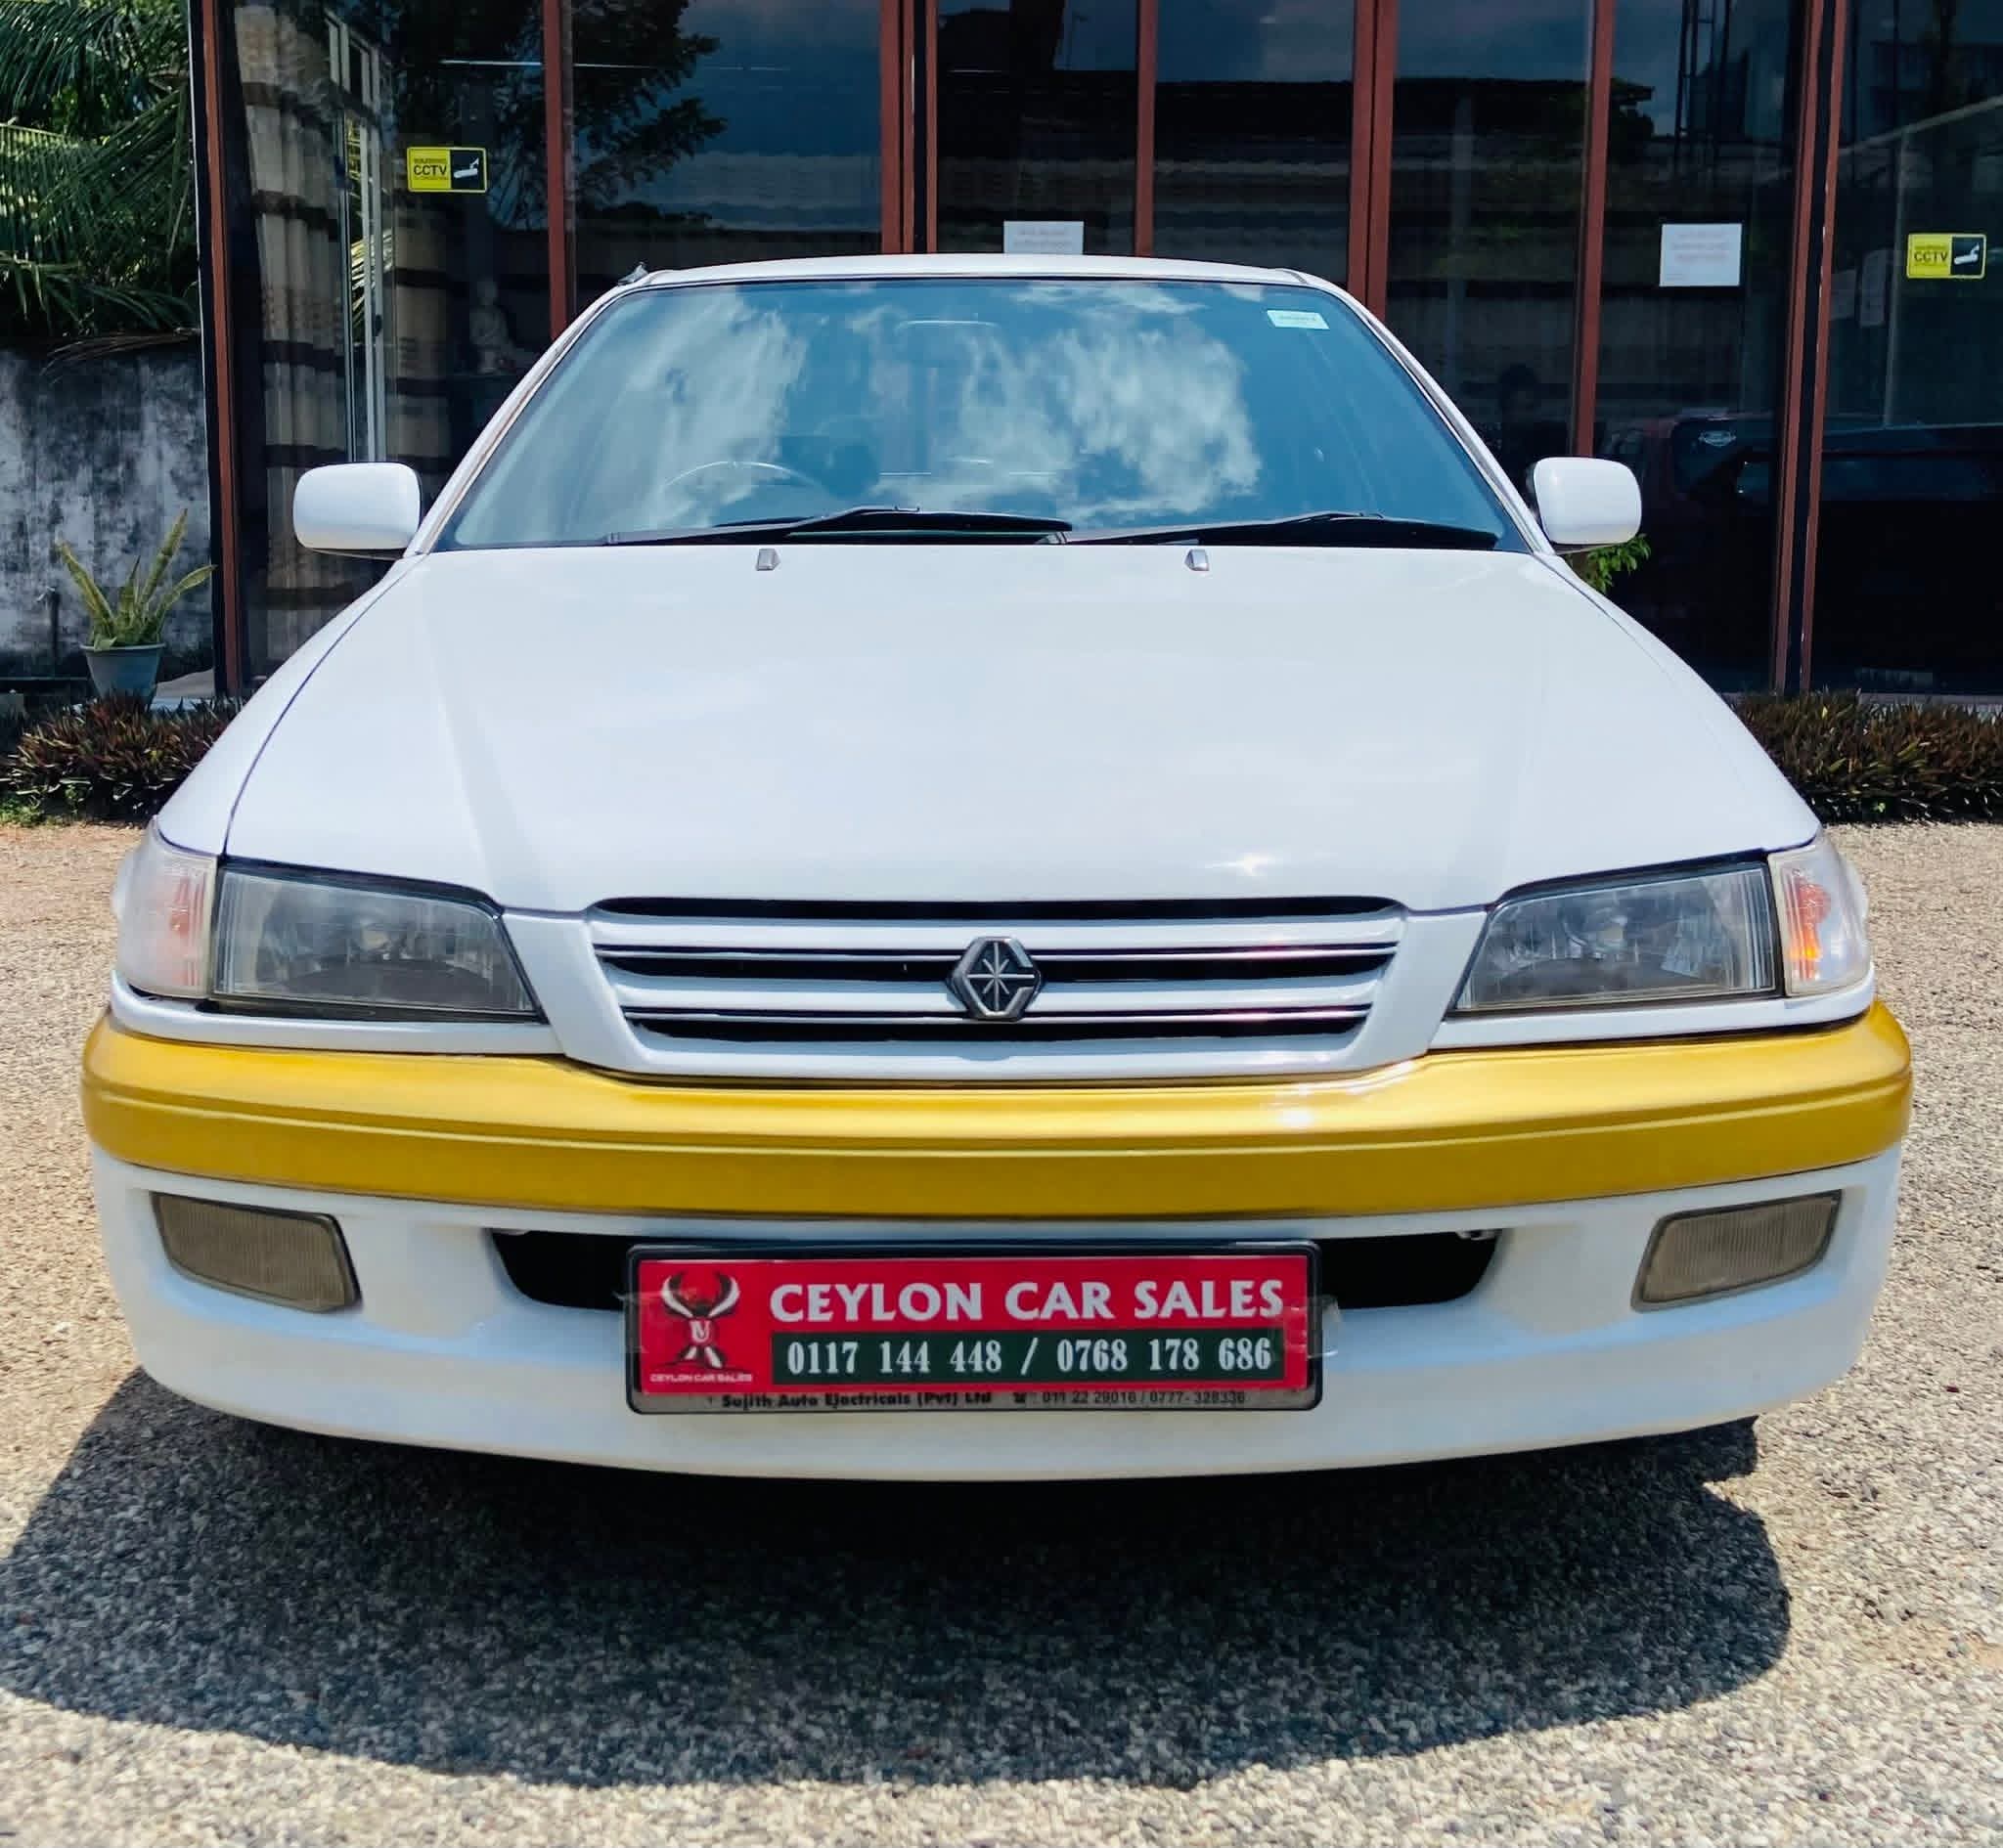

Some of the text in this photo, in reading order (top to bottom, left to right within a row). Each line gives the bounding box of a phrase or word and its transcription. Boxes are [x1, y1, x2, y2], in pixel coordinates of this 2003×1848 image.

[413, 164, 448, 176] CCTV
[1914, 251, 1947, 263] CCTV
[770, 1279, 1284, 1323] CEYLON CAR SALES
[787, 1337, 1272, 1376] 0117 144 448 / 0768 178 686
[778, 1393, 820, 1408] Auto
